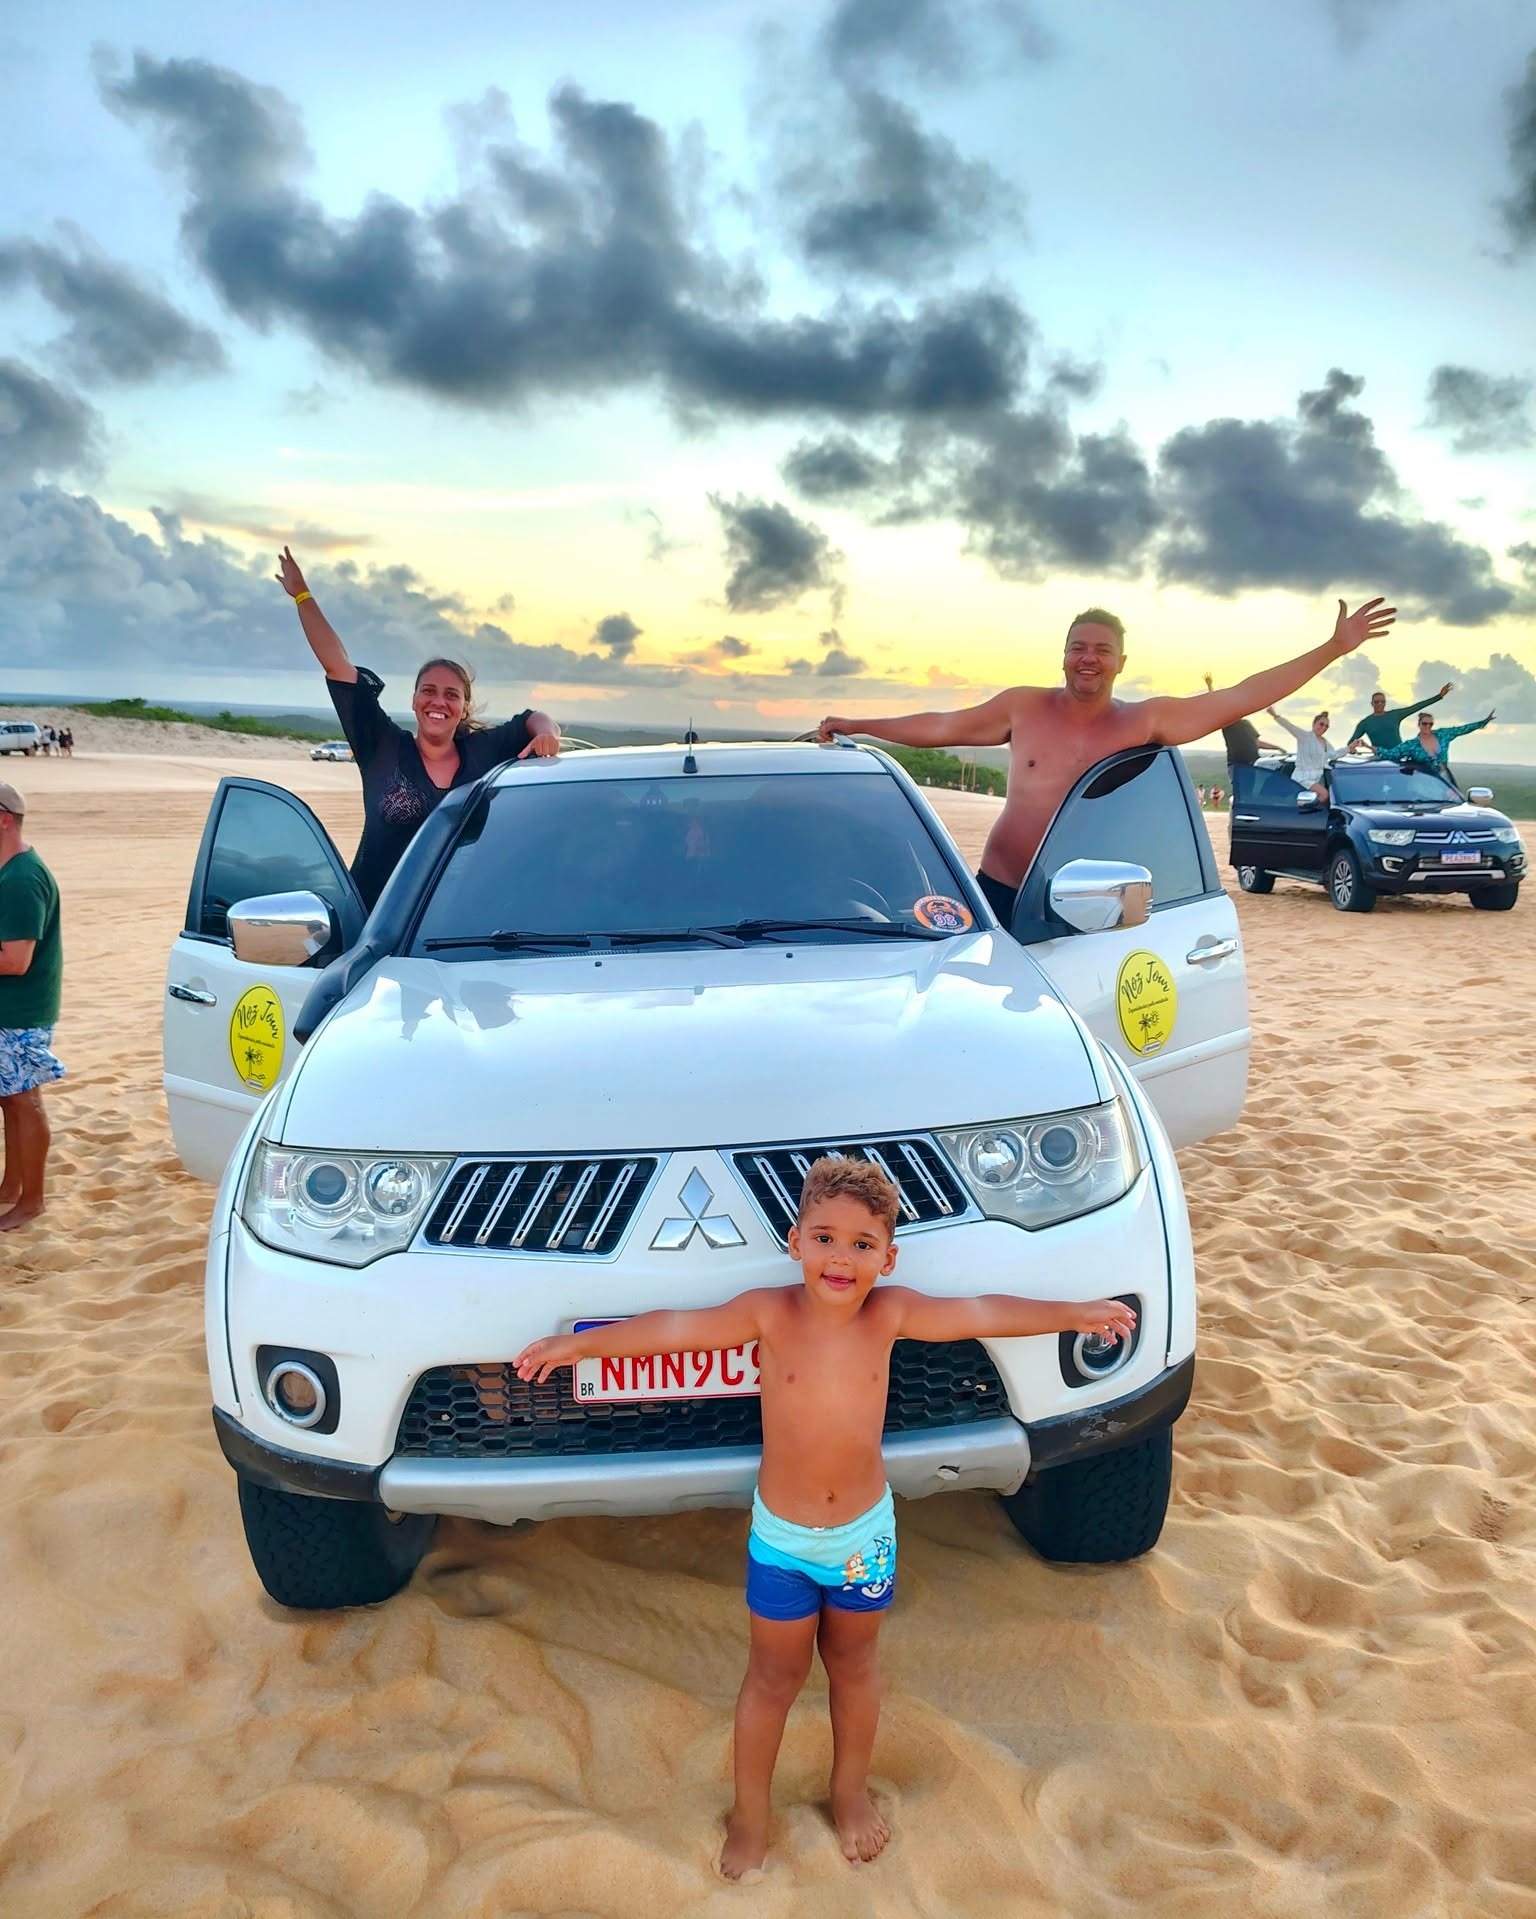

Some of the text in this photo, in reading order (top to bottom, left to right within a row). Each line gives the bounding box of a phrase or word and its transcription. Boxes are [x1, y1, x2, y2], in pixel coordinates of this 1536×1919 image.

[1146, 960, 1170, 992] Tour
[260, 1000, 279, 1039] Tour
[580, 1382, 595, 1397] BR
